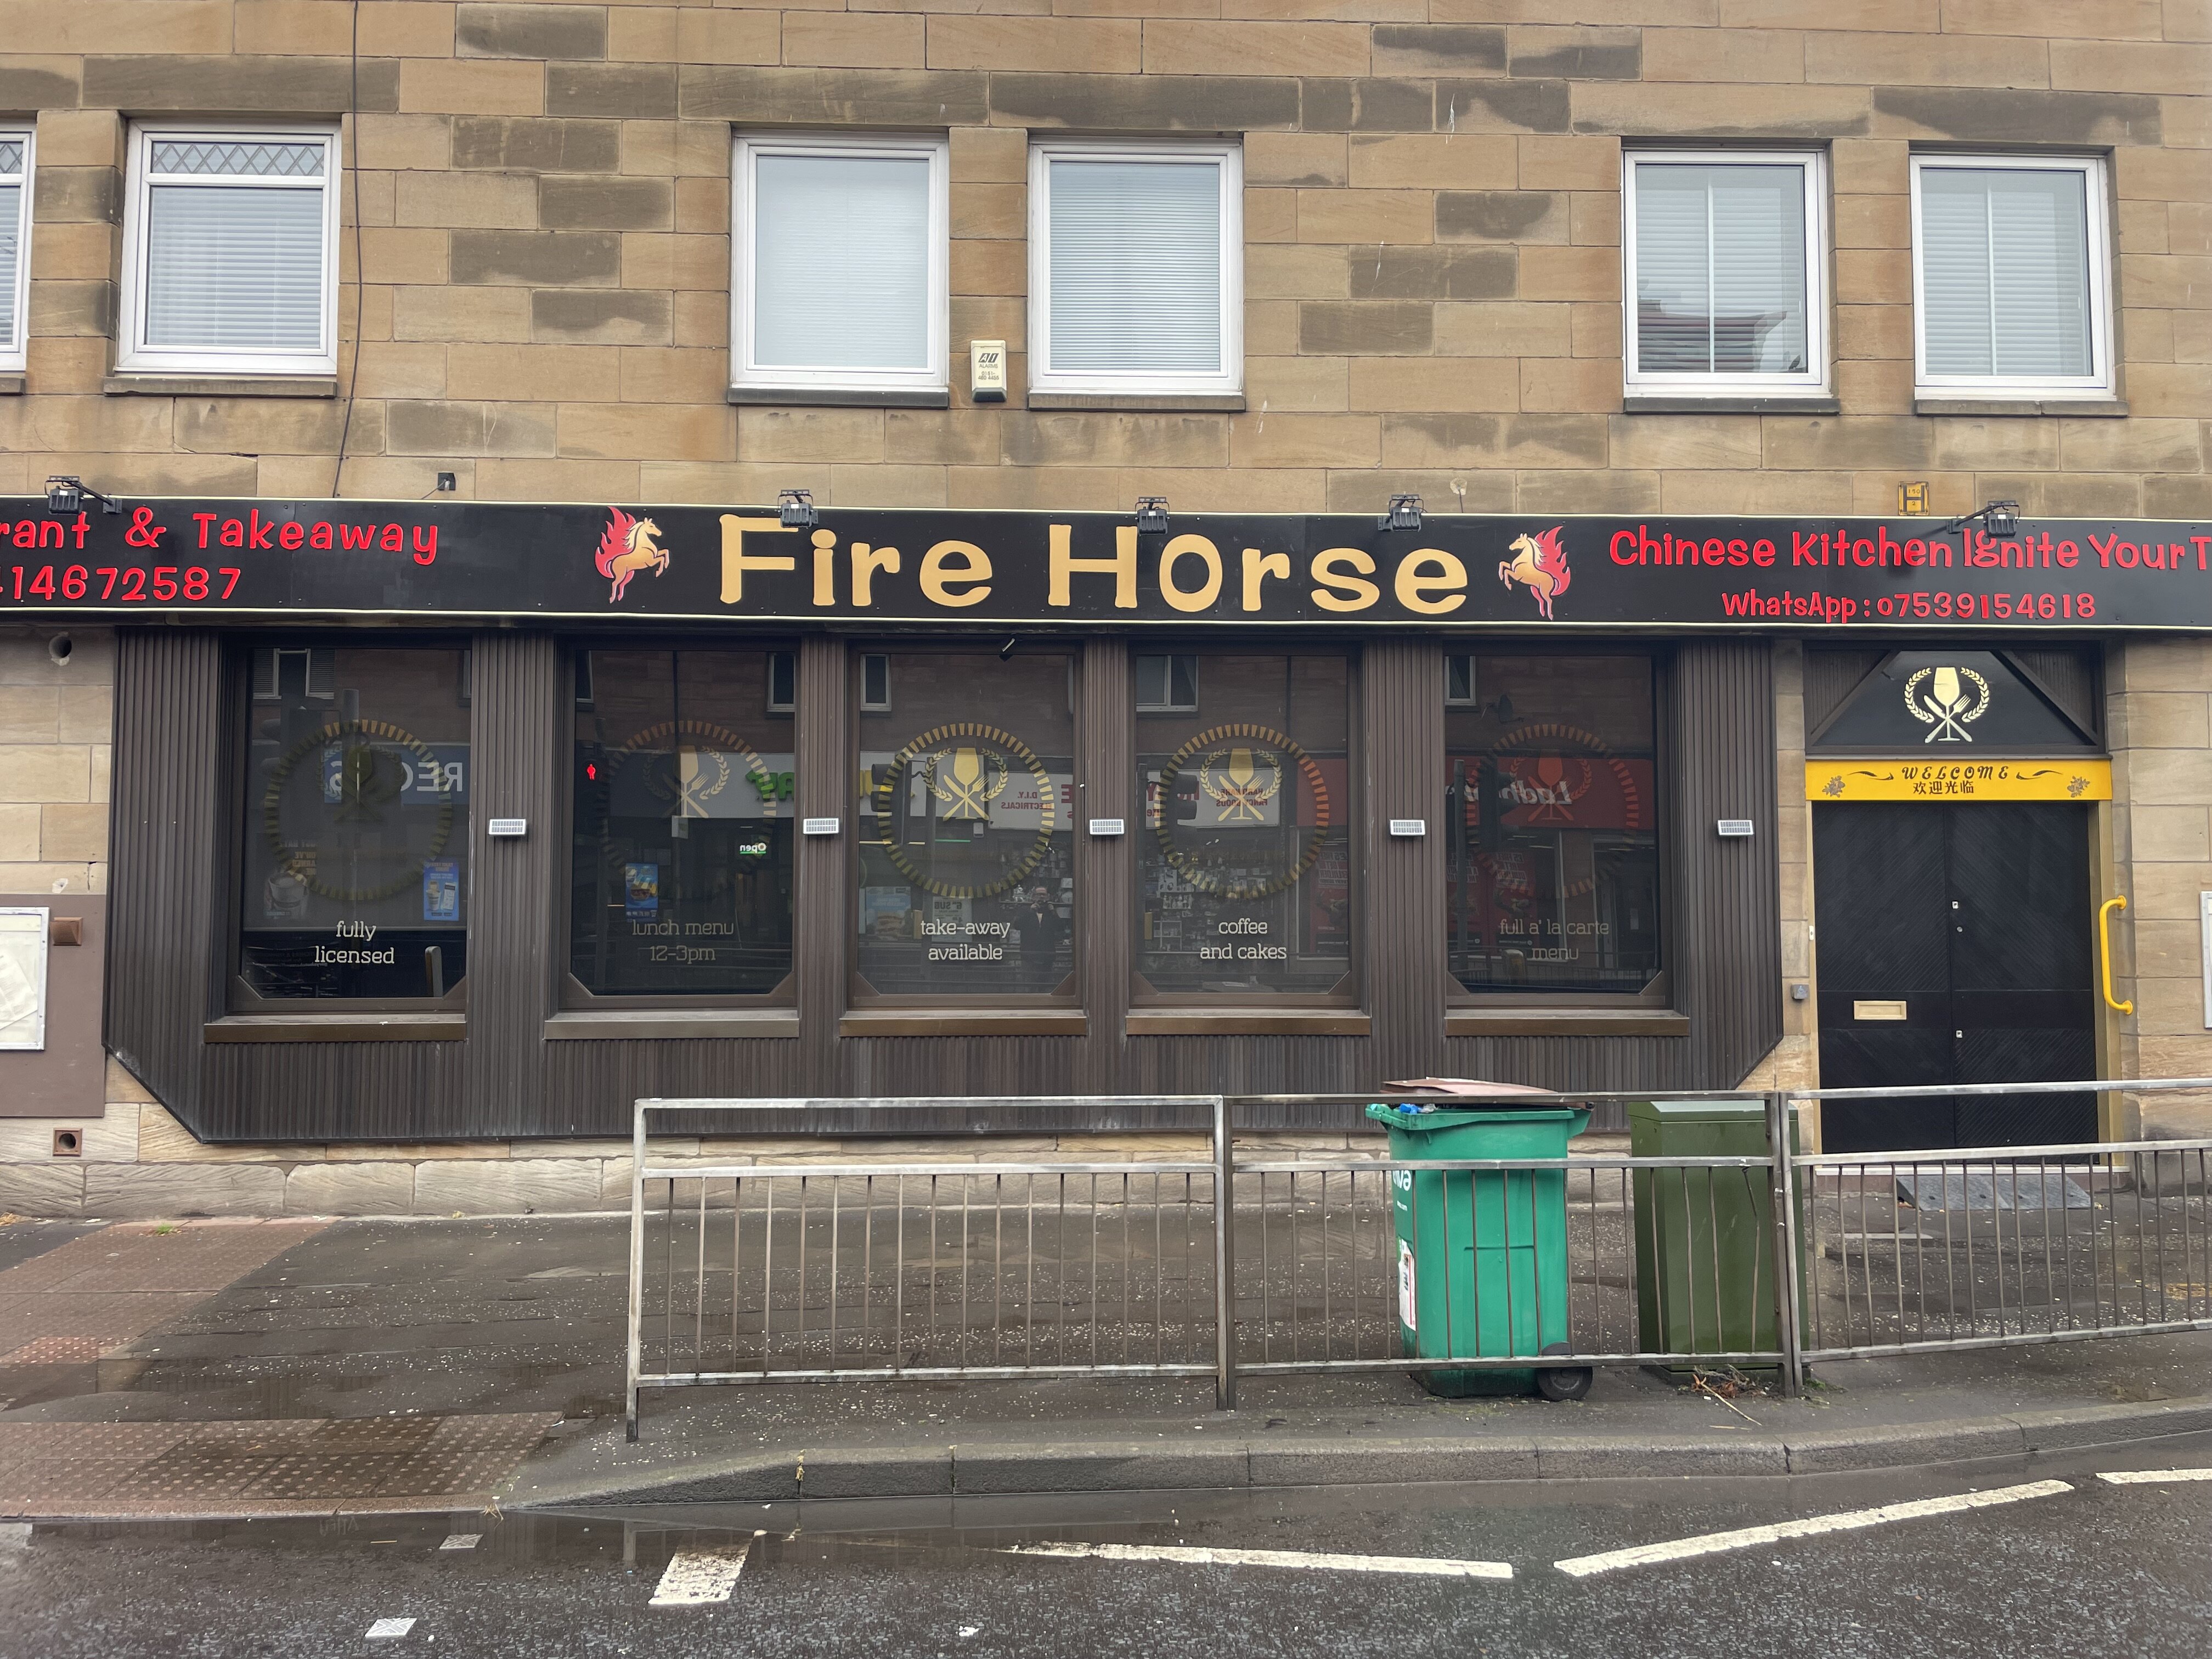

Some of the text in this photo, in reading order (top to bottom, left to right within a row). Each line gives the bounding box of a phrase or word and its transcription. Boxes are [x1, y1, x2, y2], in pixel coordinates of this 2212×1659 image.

[125, 506, 167, 548] &
[192, 509, 438, 566] Takeaway
[1610, 524, 1776, 567] Chinese
[1792, 526, 1953, 567] Kitchen
[1963, 528, 2079, 568] Ignite
[2088, 533, 2185, 569] Your
[720, 514, 992, 607] Fire
[0, 565, 241, 600] 14672587
[1901, 766, 2008, 780] WELCOME
[1913, 781, 1974, 795] 欢迎光临
[336, 920, 377, 941] fully
[632, 919, 734, 935] lunch menu
[921, 919, 1011, 939] take-away
[1218, 918, 1268, 934] coffee
[1499, 919, 1524, 935] full
[1547, 919, 1561, 935] la
[1566, 921, 1609, 935] carte
[314, 945, 394, 964] licensed
[650, 945, 716, 964] 12-3pm
[928, 944, 1003, 960] available
[1200, 943, 1287, 960] and cakes
[1531, 947, 1579, 960] menu
